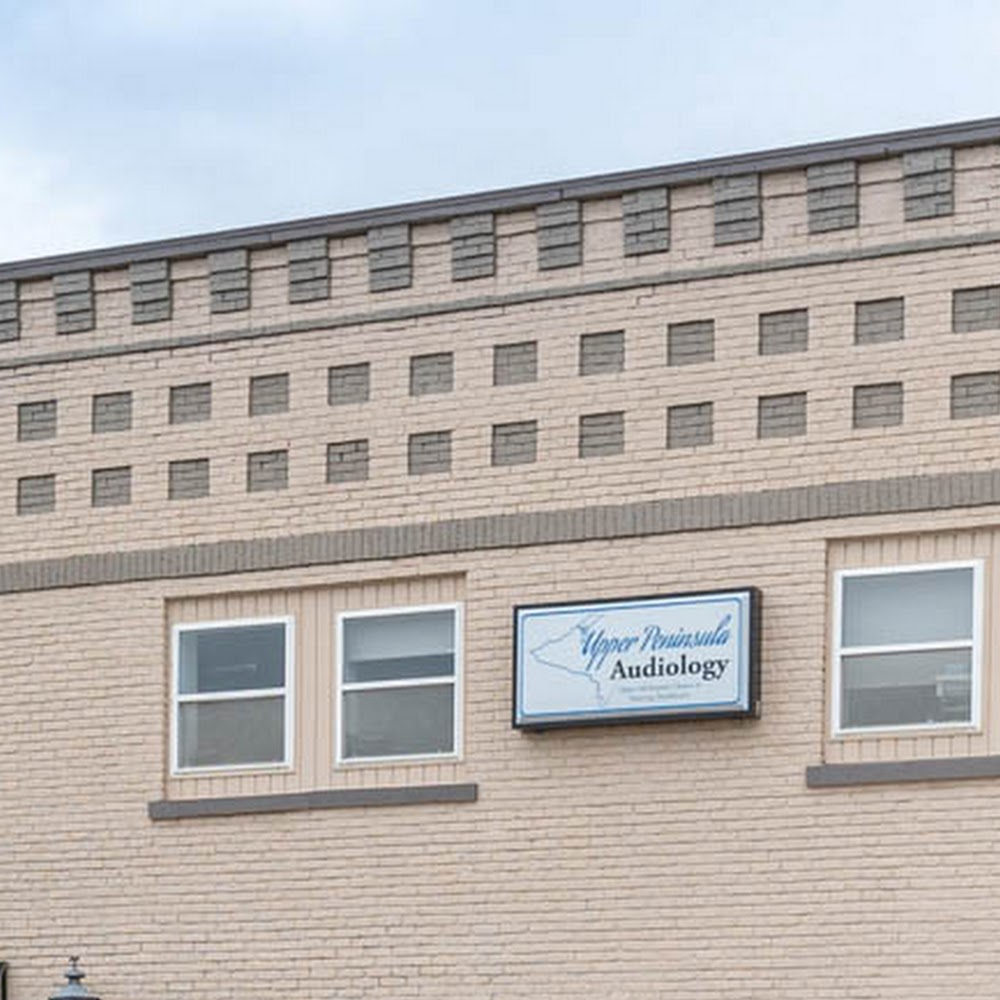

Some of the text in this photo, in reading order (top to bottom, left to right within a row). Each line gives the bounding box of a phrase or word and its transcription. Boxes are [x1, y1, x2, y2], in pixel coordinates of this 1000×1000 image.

[581, 613, 732, 672] Upper Peninsula
[609, 653, 730, 680] Audiology
